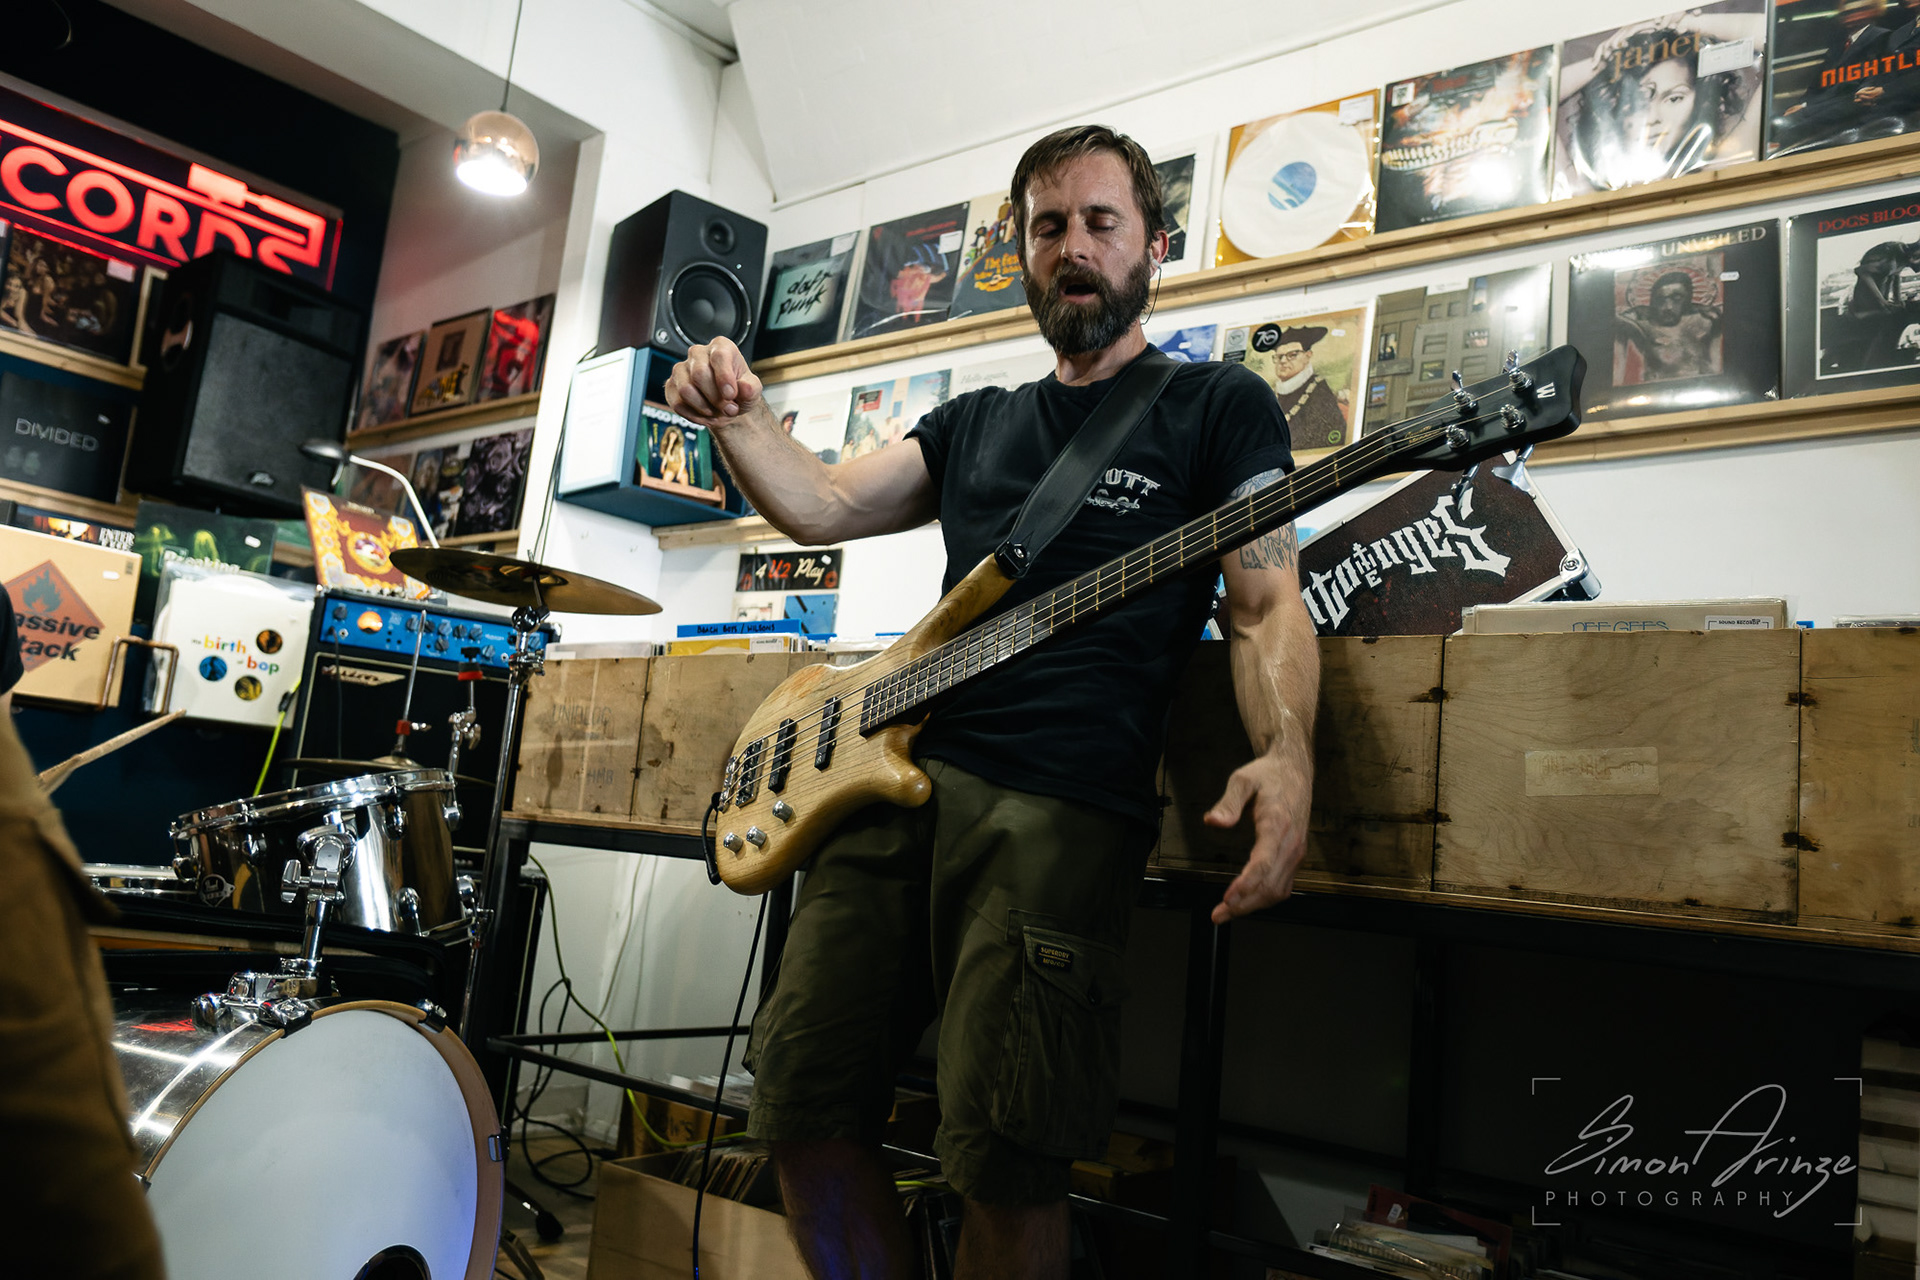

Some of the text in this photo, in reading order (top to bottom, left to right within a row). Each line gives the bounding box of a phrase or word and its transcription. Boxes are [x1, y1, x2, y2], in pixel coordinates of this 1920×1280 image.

[1821, 48, 1920, 88] NIGHTL
[1818, 213, 1869, 234] DOGS
[787, 269, 834, 295] daft
[775, 284, 828, 325] punk
[15, 417, 100, 452] DIVIDED
[1103, 467, 1161, 496] OTT
[755, 563, 768, 579] 4
[793, 558, 826, 586] Play
[203, 634, 246, 654] birth
[246, 655, 280, 675] bop
